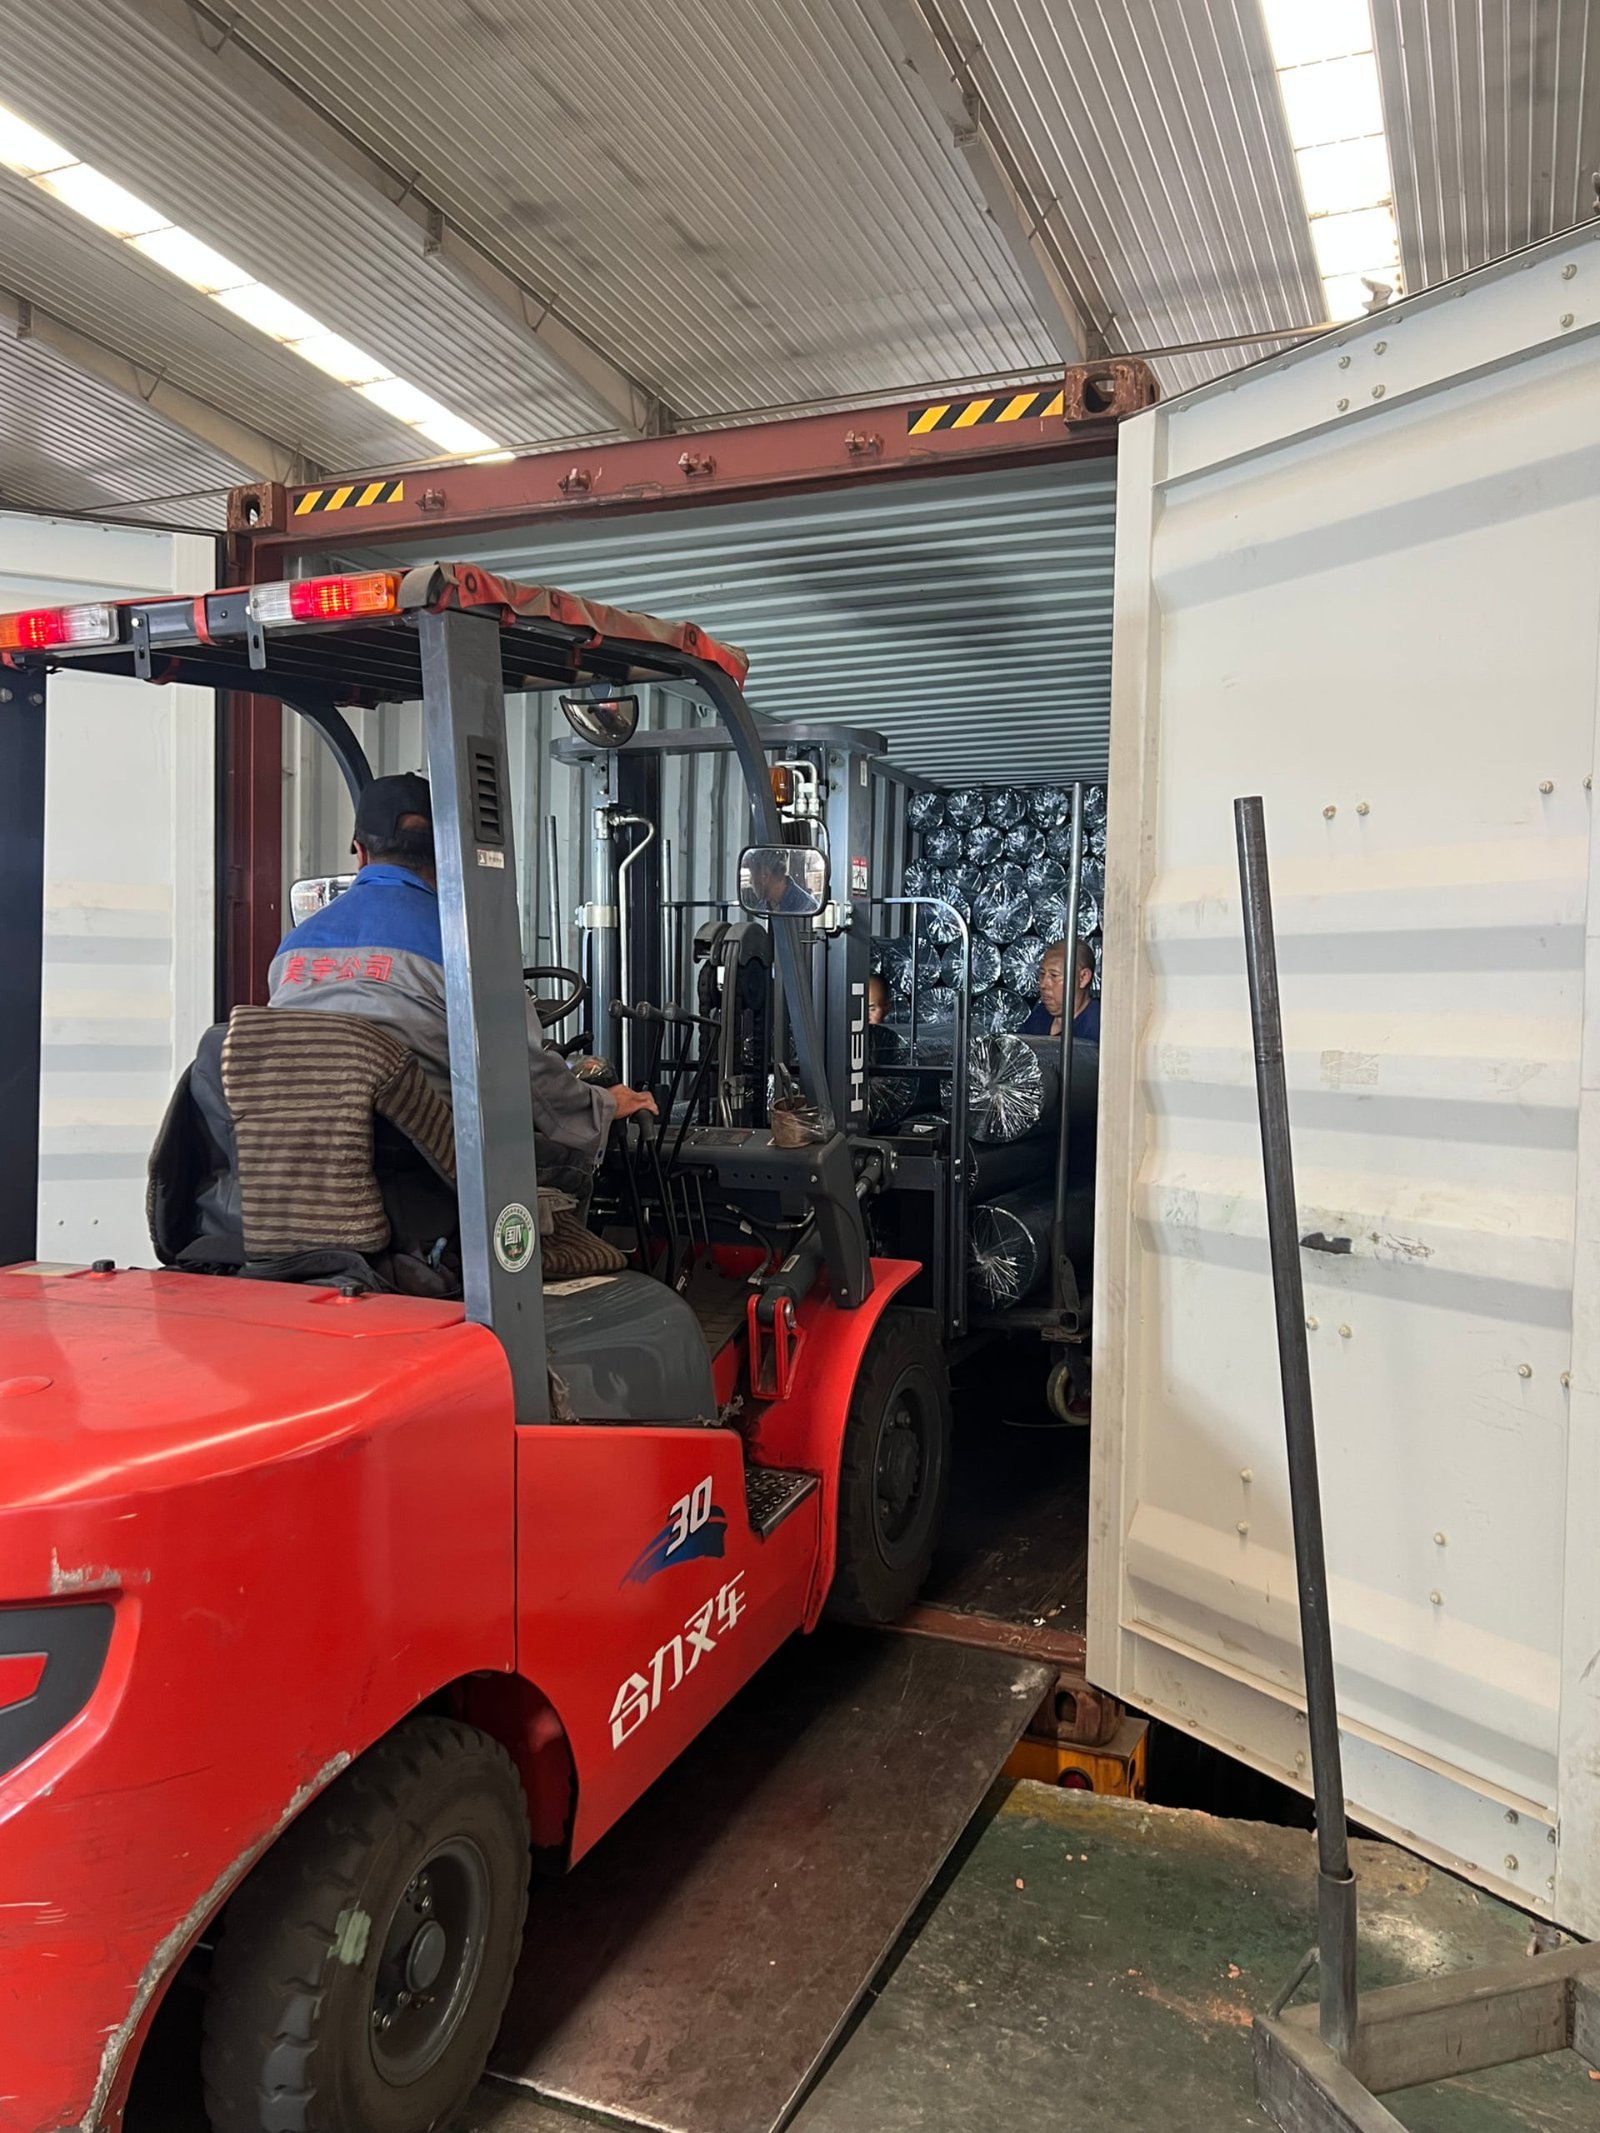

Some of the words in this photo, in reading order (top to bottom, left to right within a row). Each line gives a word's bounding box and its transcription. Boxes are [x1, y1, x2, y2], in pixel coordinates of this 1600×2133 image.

[850, 982, 865, 1112] HELI
[665, 1474, 713, 1557] 30
[608, 1569, 747, 1750] 合力叉车
